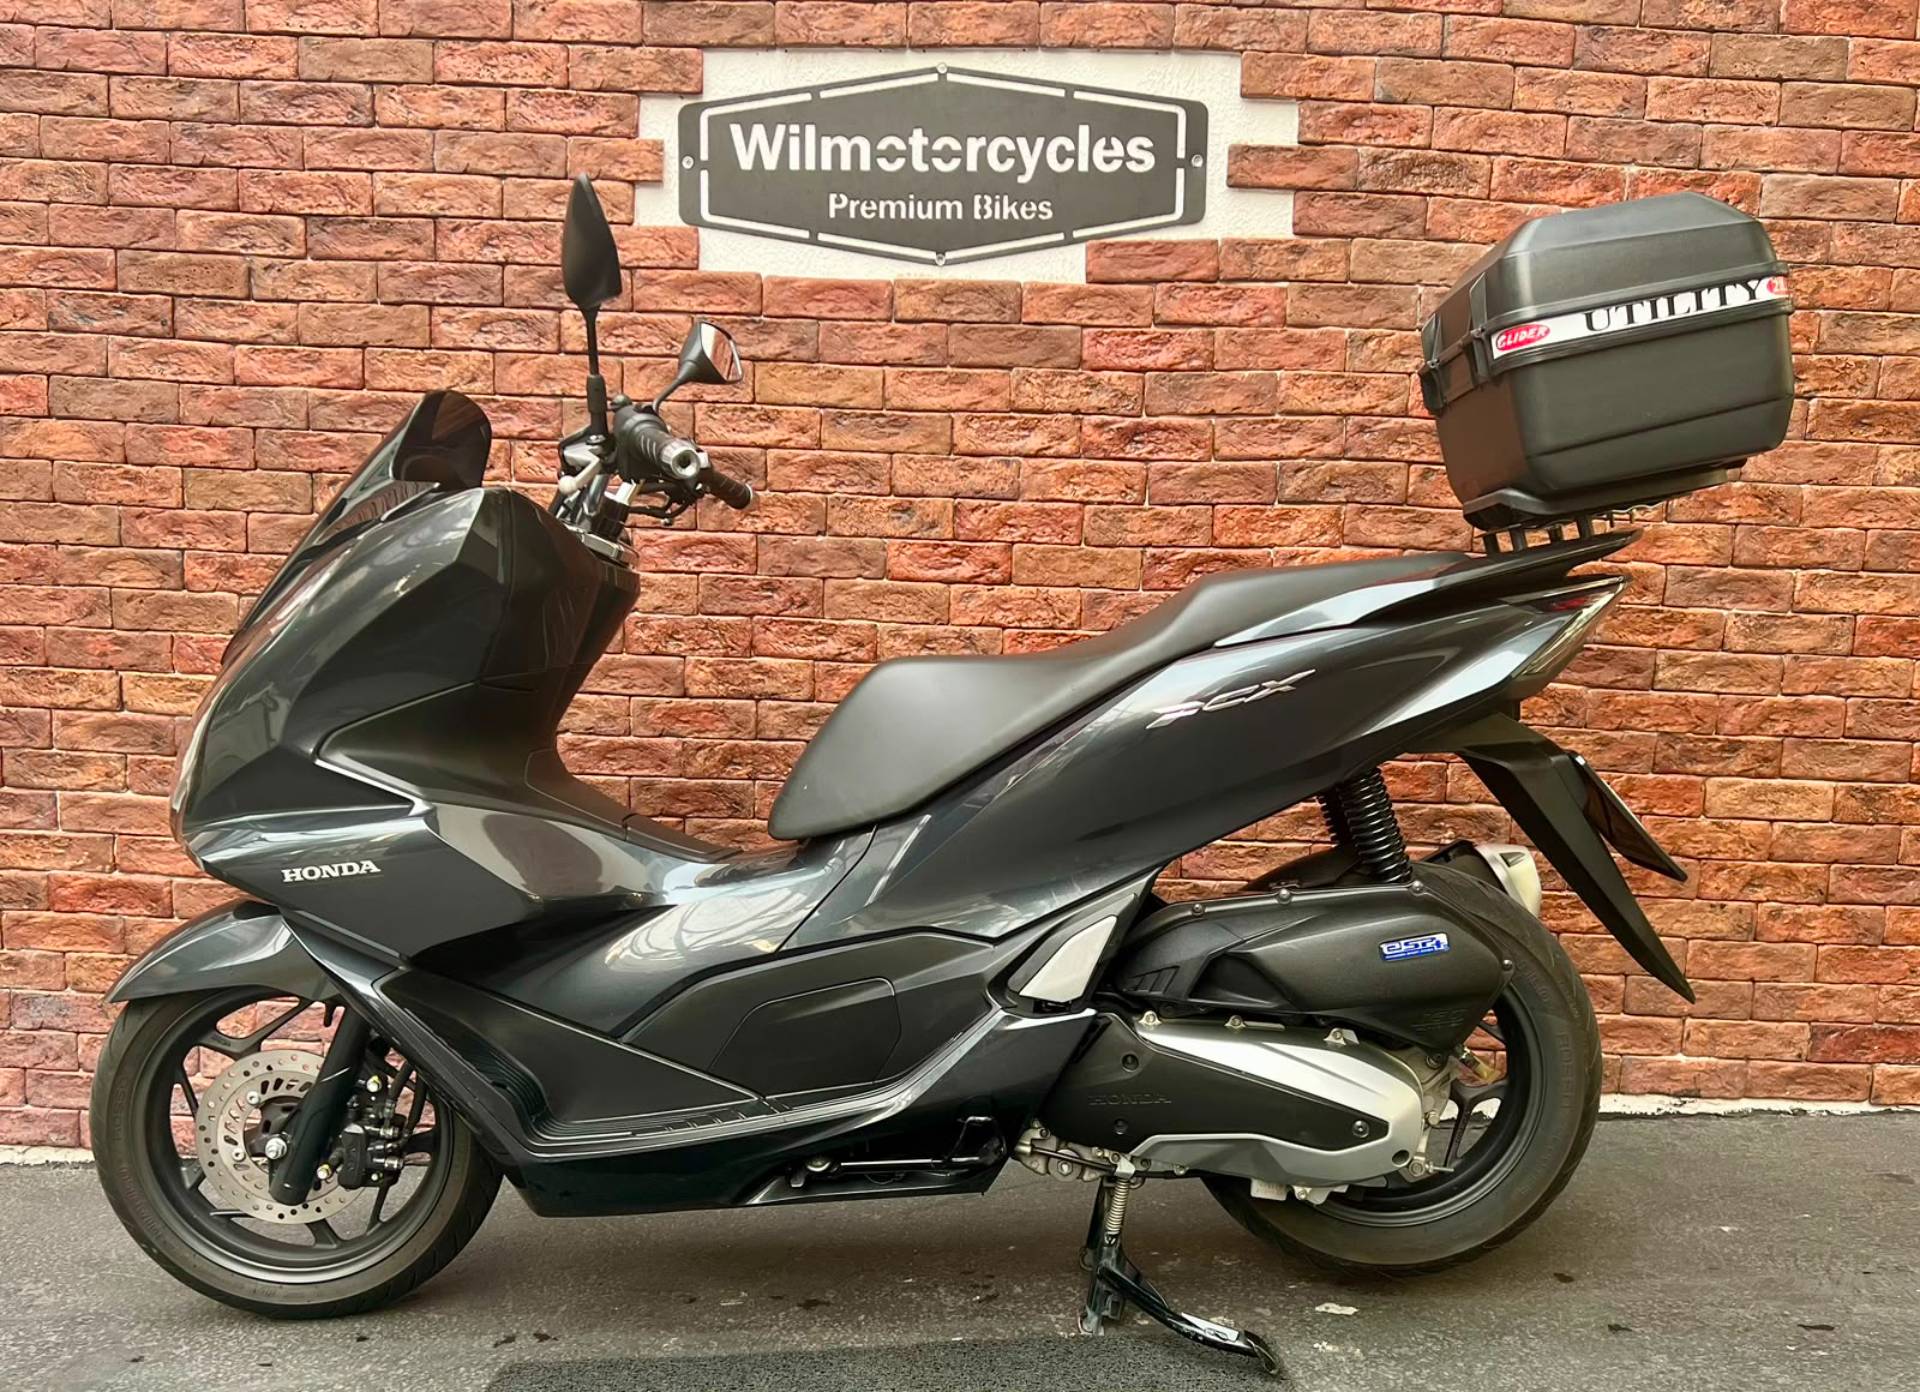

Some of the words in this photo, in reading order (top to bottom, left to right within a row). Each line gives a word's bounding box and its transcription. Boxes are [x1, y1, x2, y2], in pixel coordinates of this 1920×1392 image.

[729, 123, 1156, 184] Wilmotorcycles
[829, 193, 963, 219] Premium
[974, 194, 1053, 220] Bikes
[1496, 325, 1549, 350] GLIDER
[1583, 280, 1764, 332] UTILITY
[281, 860, 381, 883] HONDA
